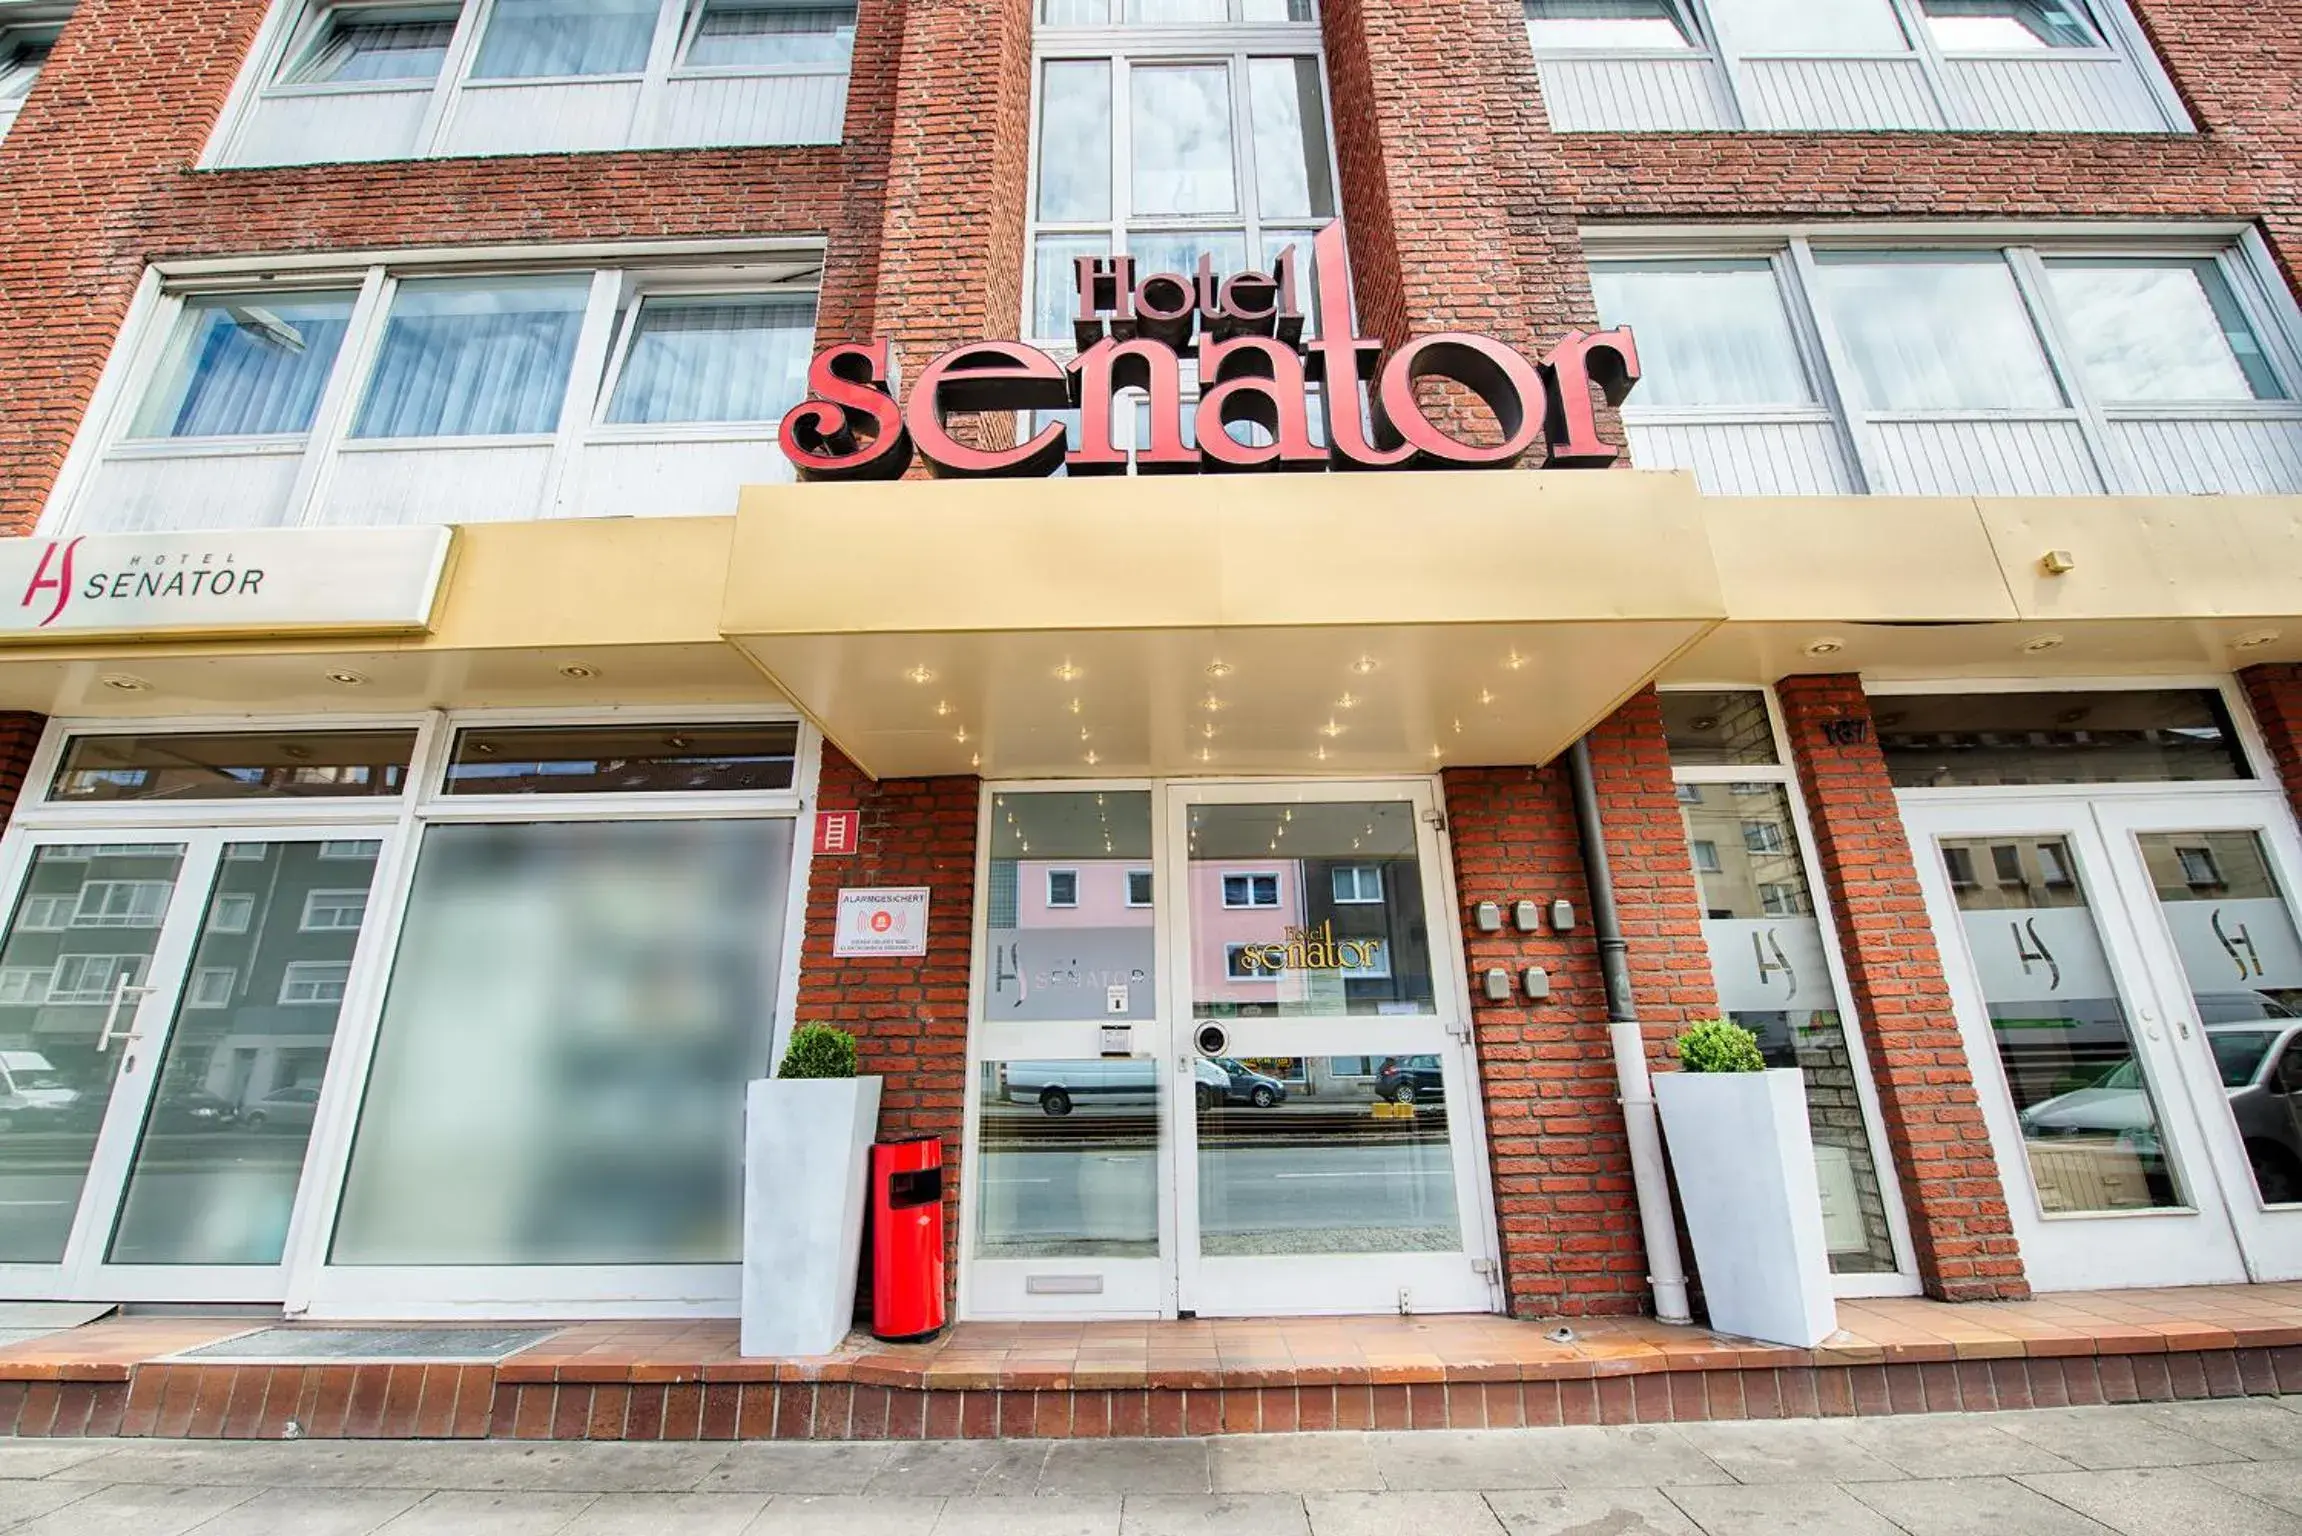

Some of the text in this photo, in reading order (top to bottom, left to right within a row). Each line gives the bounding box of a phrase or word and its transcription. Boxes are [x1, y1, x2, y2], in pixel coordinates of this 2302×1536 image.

[1074, 245, 1303, 344] Hotel
[778, 218, 1643, 480] senator
[84, 568, 265, 600] SENATOR
[130, 553, 236, 566] HOTEL
[1240, 917, 1380, 969] senator
